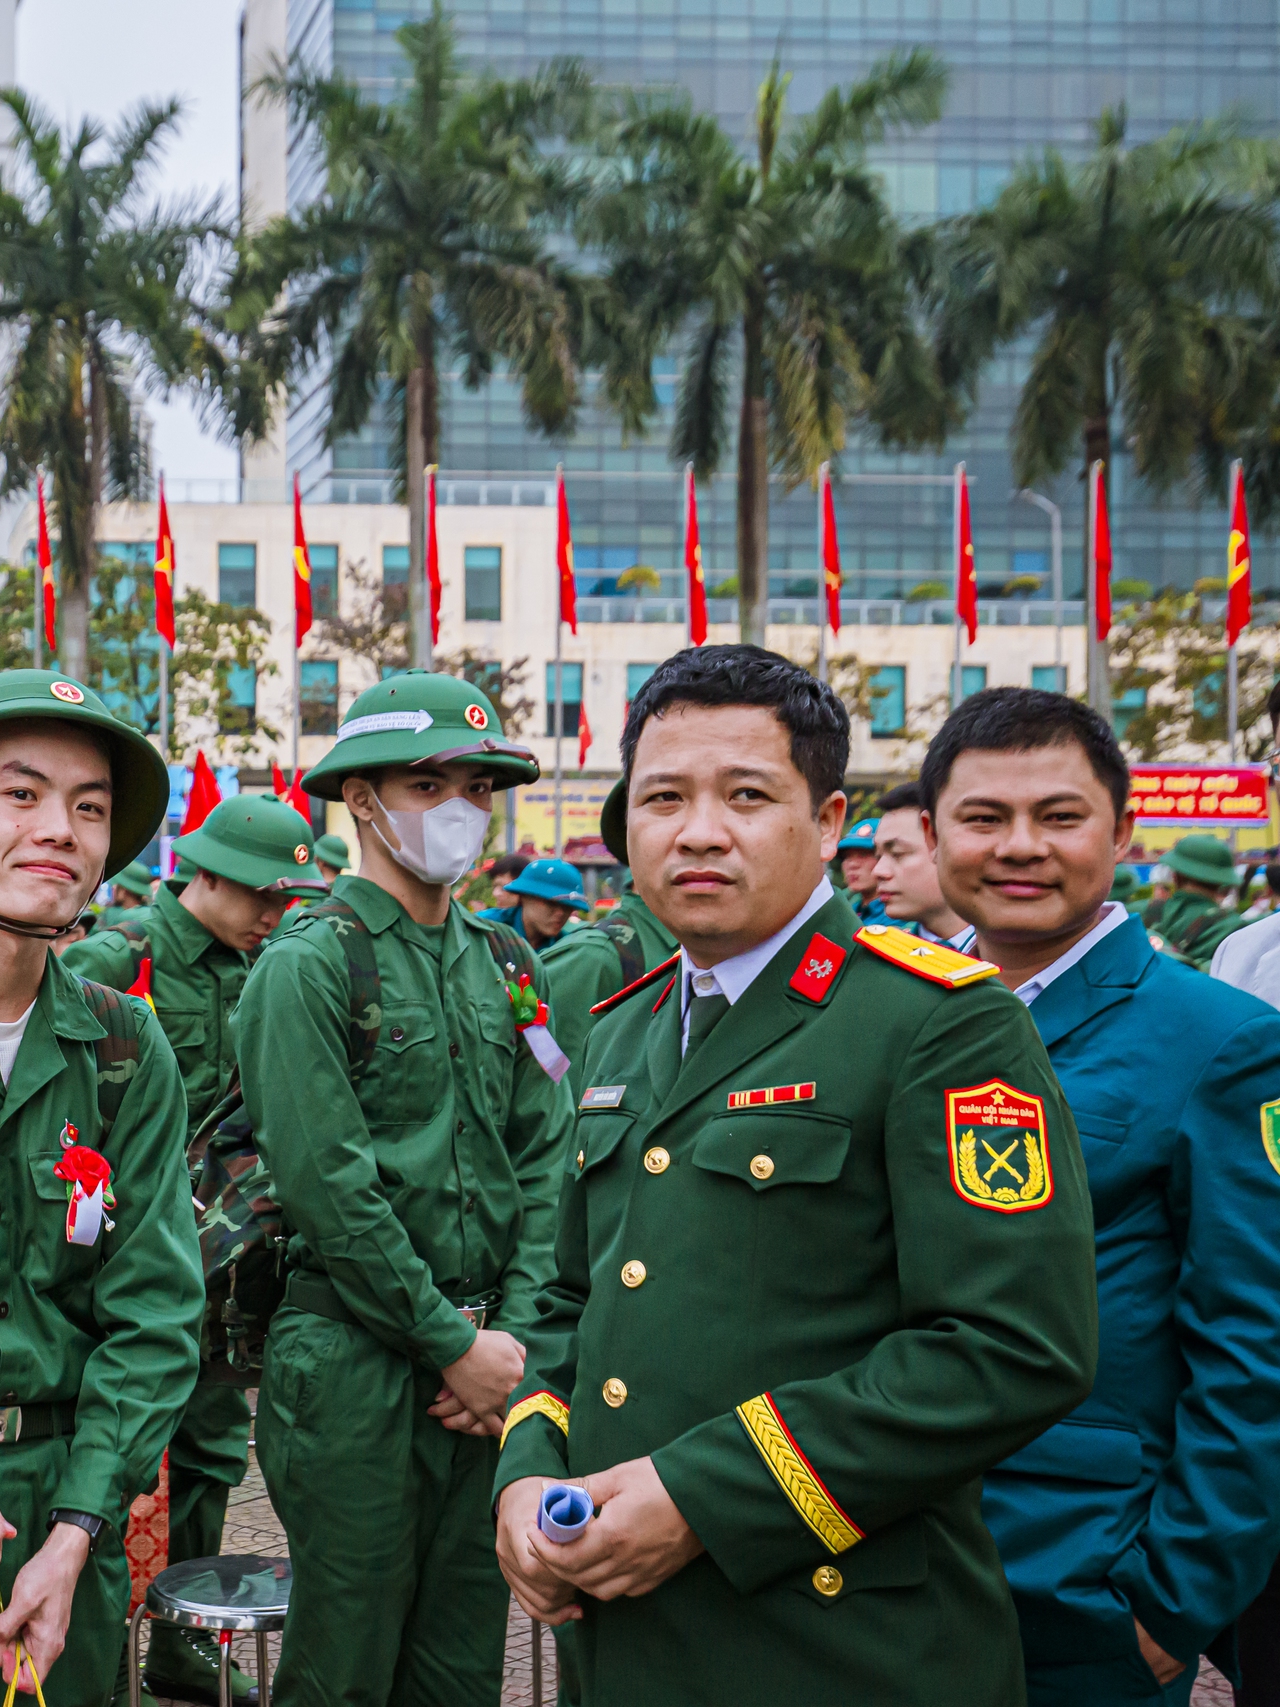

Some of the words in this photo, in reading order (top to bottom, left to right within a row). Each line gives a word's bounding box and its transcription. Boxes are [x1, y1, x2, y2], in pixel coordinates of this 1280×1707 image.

[959, 1104, 981, 1114] QUÂN
[983, 1105, 997, 1115] ĐỘI
[998, 1106, 1019, 1116] NHÂN
[1020, 1108, 1035, 1118] DÂN
[981, 1115, 998, 1125] VIỆT
[1000, 1117, 1018, 1125] NAM
